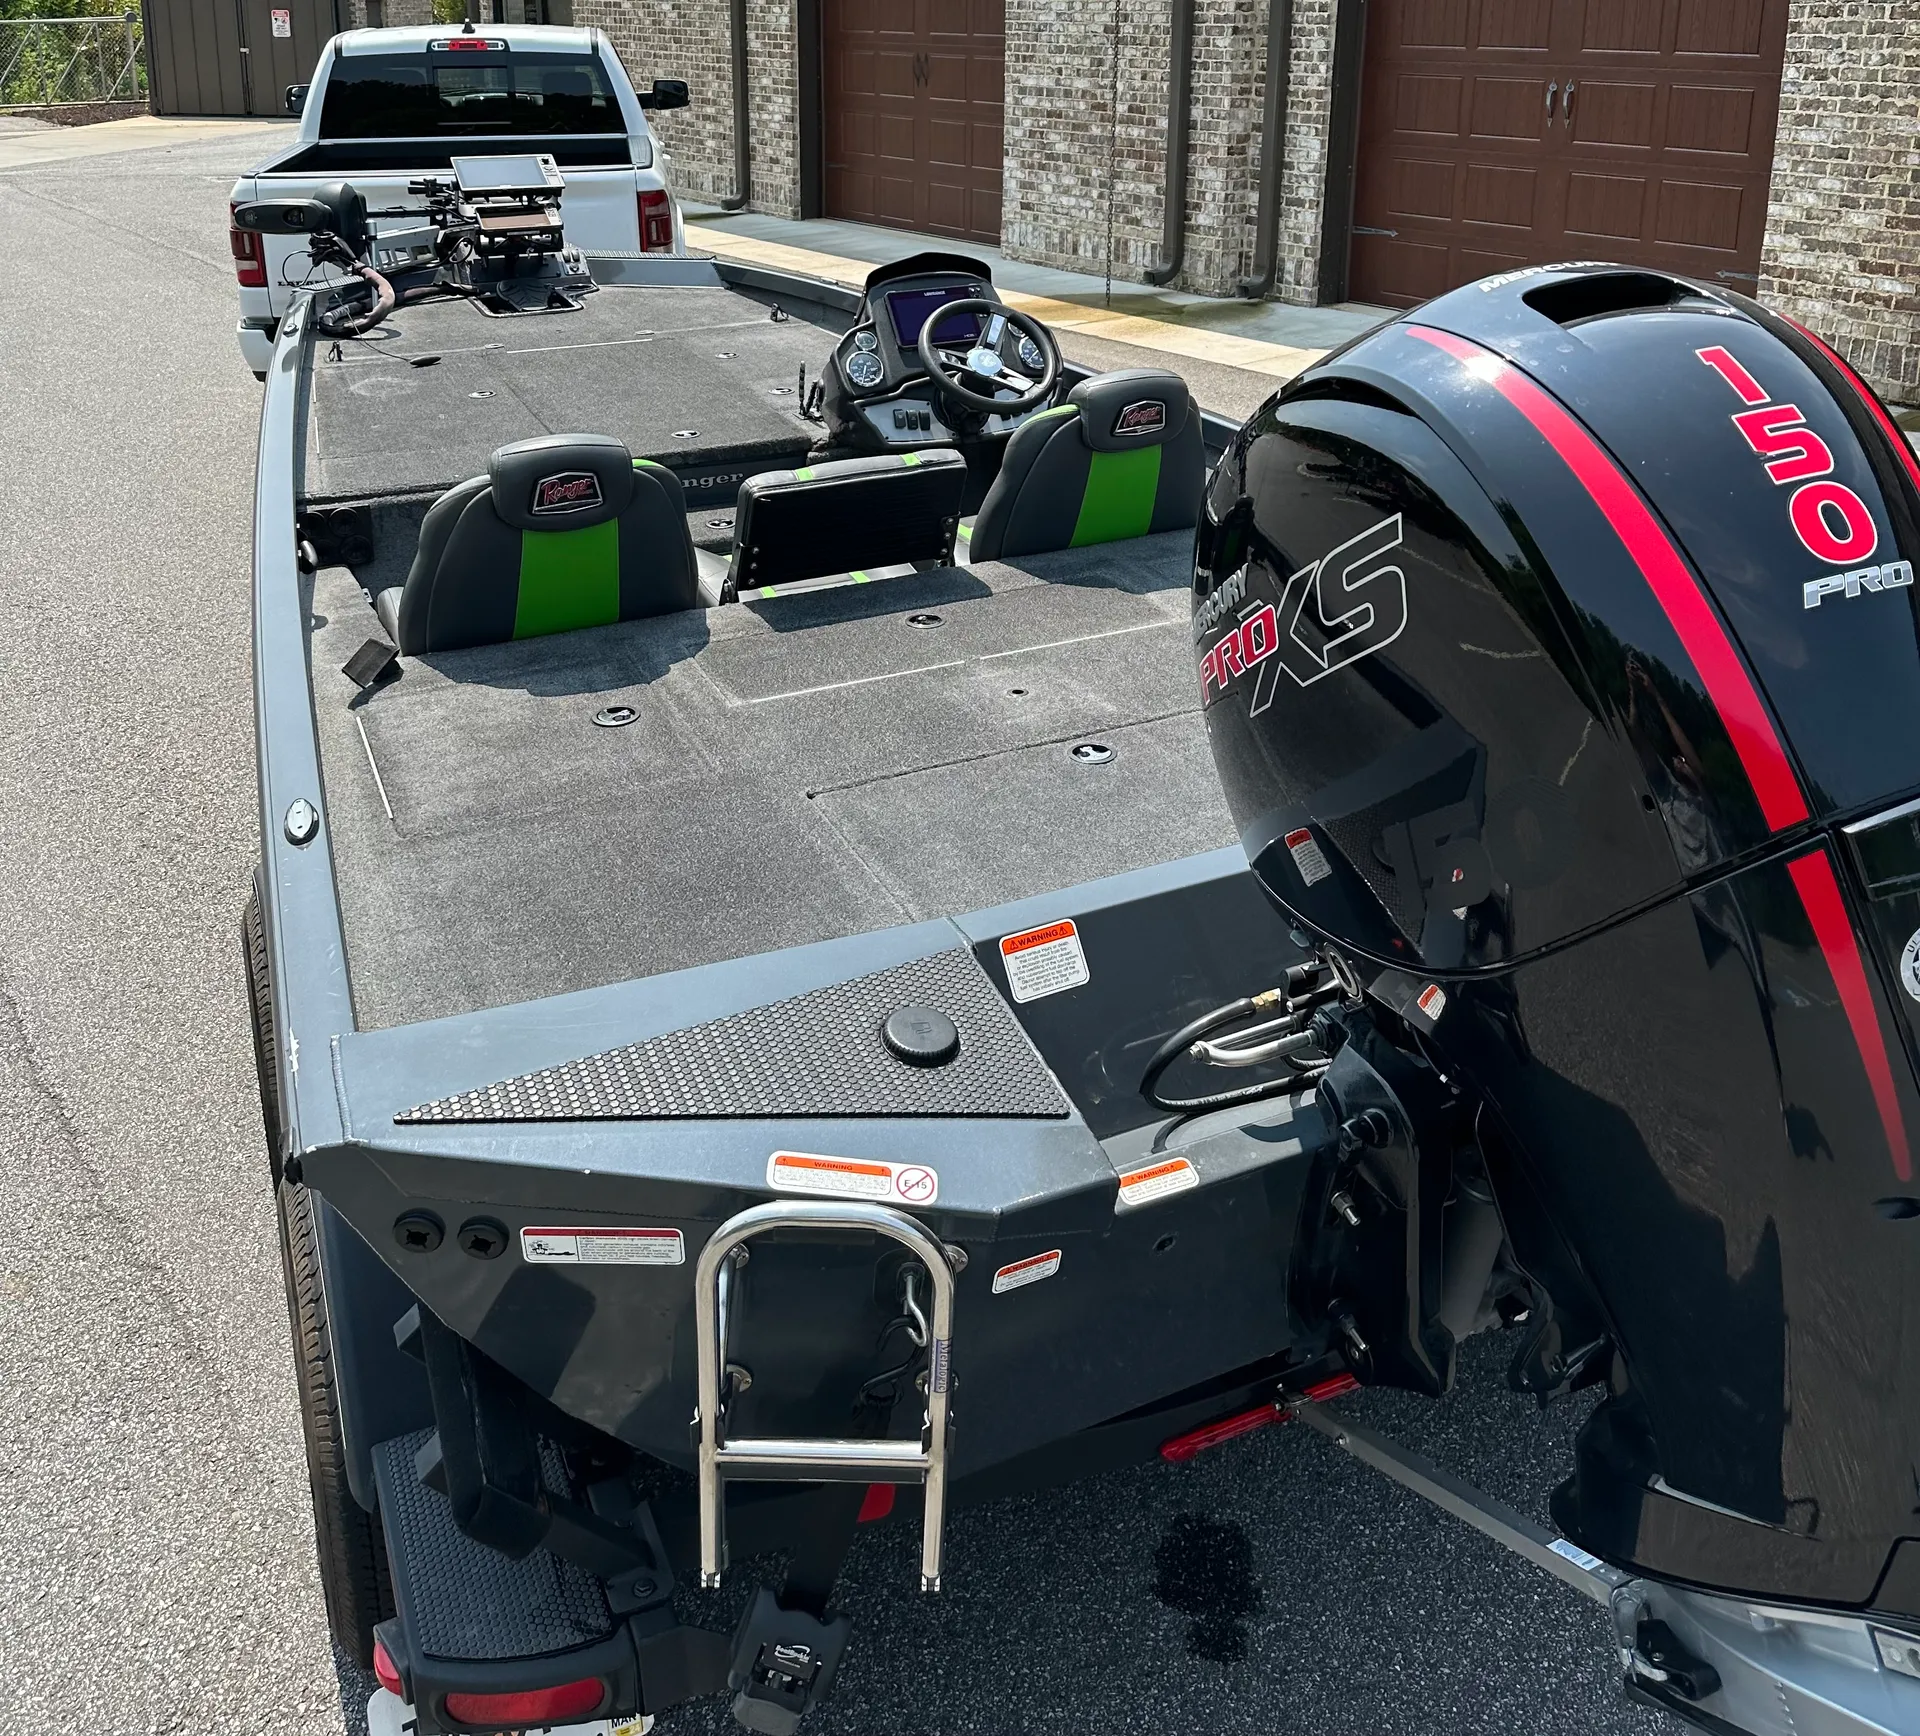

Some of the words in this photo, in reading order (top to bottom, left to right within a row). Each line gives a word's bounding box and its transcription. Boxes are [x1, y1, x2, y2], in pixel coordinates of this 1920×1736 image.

[1695, 346, 1878, 565] 150
[681, 472, 744, 488] nger
[541, 479, 594, 505] Ranger
[1803, 560, 1914, 609] PRO
[1193, 562, 1249, 645] ERCURY
[1200, 604, 1279, 705] PRO
[1250, 512, 1408, 718] XS
[1018, 929, 1058, 946] WARNING
[814, 1161, 853, 1171] WARNING
[1137, 1166, 1170, 1180] WARNING
[904, 1179, 928, 1190] E-15
